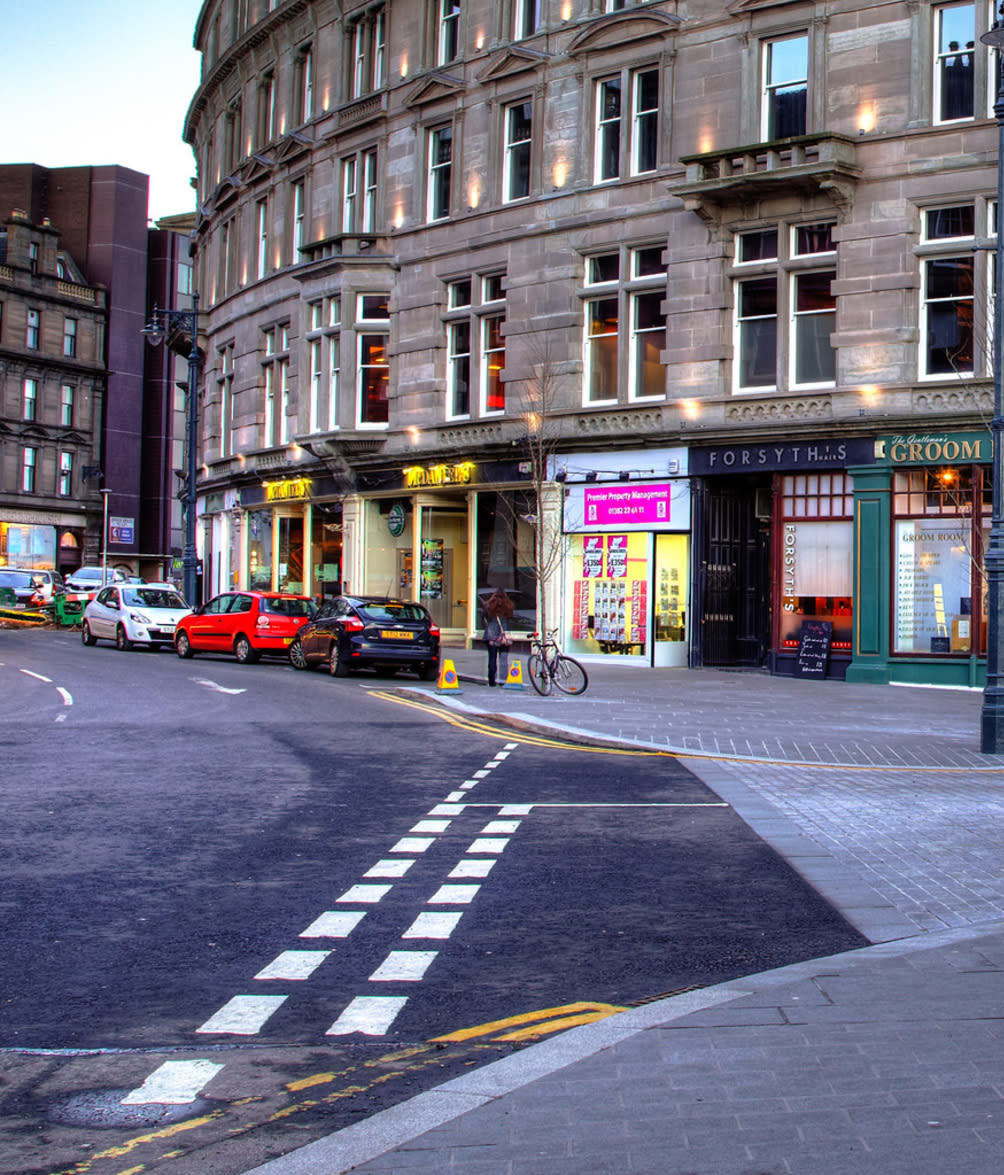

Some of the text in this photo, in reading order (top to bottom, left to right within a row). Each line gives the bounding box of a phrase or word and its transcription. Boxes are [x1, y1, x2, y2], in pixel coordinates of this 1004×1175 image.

[709, 445, 847, 467] FORSYTH'S
[891, 440, 981, 462] GROOM
[587, 490, 668, 502] Premier Property Management
[902, 533, 935, 542] GROOM
[785, 525, 795, 611] FORSYTH'S
